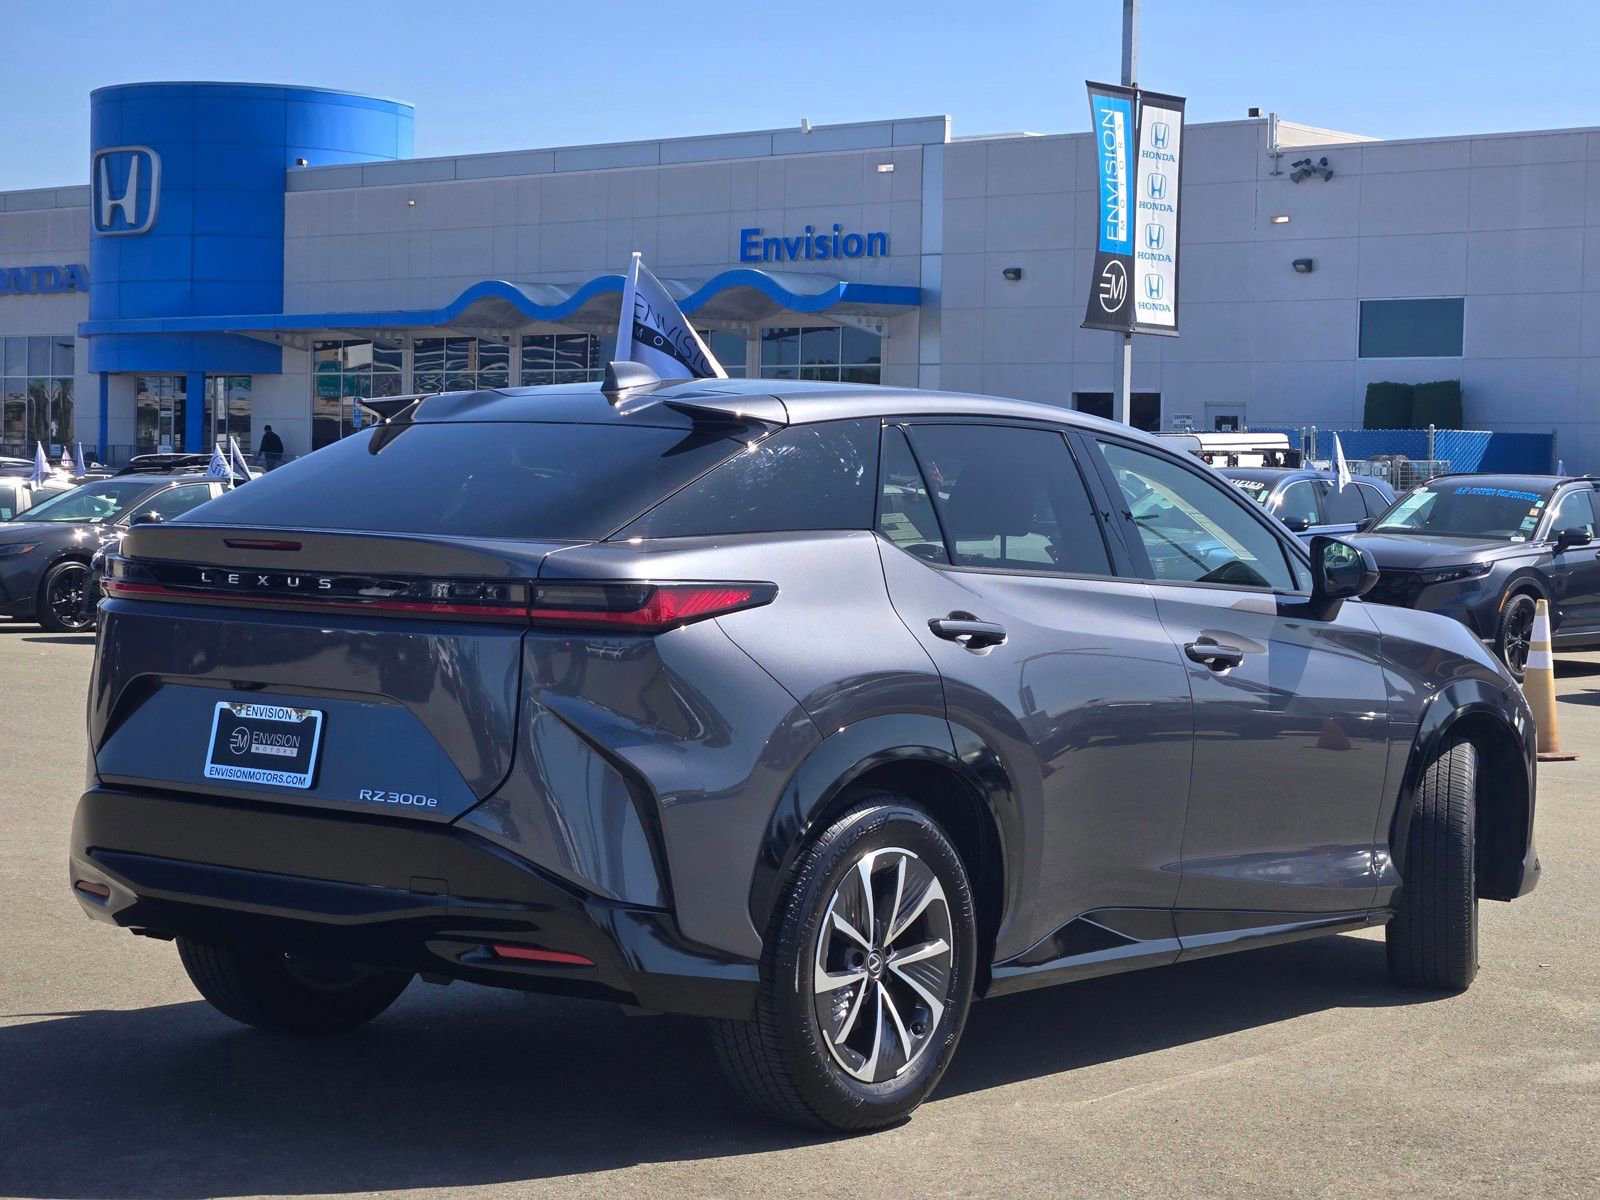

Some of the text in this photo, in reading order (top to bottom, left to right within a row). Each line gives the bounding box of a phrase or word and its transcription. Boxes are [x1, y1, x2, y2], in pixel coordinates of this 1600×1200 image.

[1141, 150, 1176, 163] HONDA
[1101, 109, 1119, 241] ENVISION
[1138, 201, 1174, 213] HONDA
[740, 223, 888, 262] Envision
[1137, 251, 1172, 263] HONDA
[1137, 301, 1172, 313] HONDA
[633, 291, 717, 376] ENVISIO
[201, 572, 332, 590] LEXUS
[245, 705, 292, 720] ENVISION
[252, 731, 301, 748] ENVISION
[254, 745, 295, 756] MOTORS
[209, 766, 307, 786] ENVISIONMOTORS.COM
